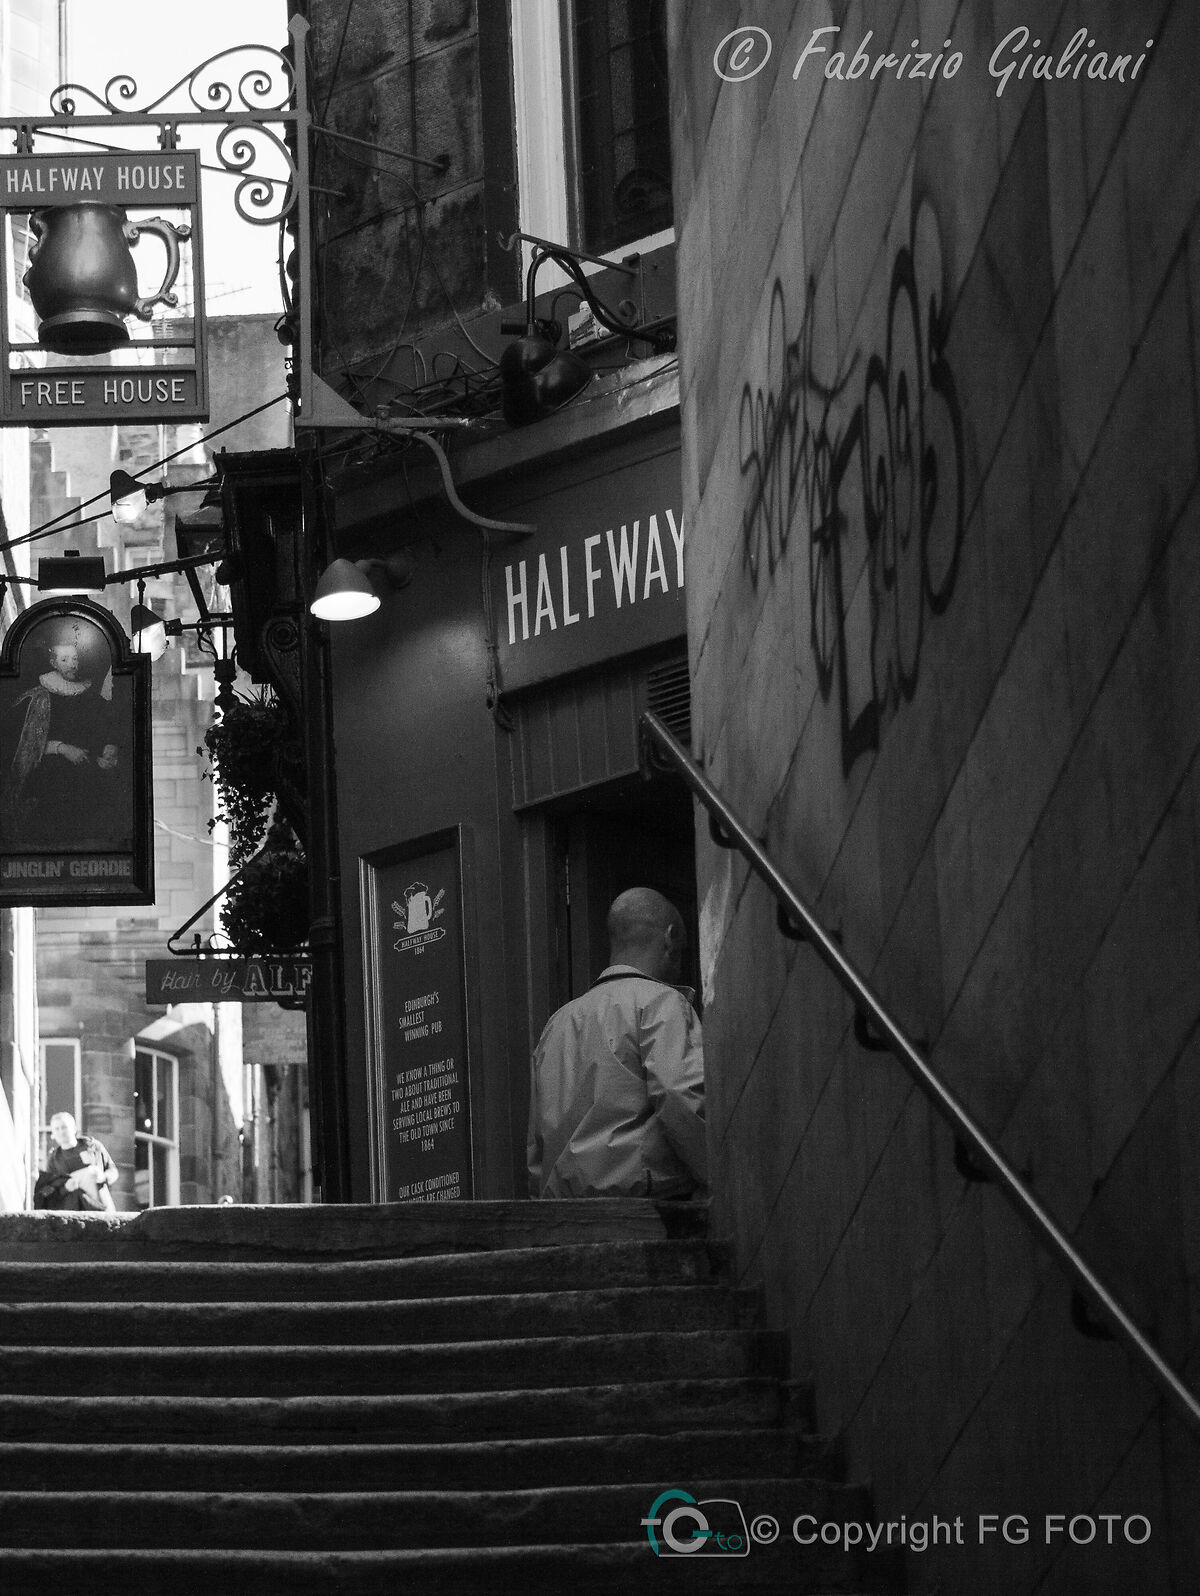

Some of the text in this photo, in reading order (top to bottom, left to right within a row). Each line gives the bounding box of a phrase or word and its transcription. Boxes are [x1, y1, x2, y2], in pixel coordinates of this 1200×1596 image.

[6, 165, 186, 193] HALFWAY HOUSE
[20, 378, 186, 406] FREE HOUSE
[504, 508, 685, 645] HALFWAY
[3, 859, 131, 878] JINGLIN' GEORDIE
[401, 930, 439, 948] HALFWAY HOUSE
[161, 969, 200, 991] Hair
[212, 967, 241, 994] by
[404, 991, 440, 1013] EDINBURGH'S
[398, 1011, 425, 1029] SMALLEST
[404, 1020, 443, 1042] WINNING PUB
[396, 1057, 455, 1085] WE KNOW A THING OR
[391, 1071, 459, 1101] TWO ABOUT TRADITIONAL
[400, 1088, 452, 1114] ALE AND HAVE BEEN
[392, 1101, 460, 1131] SERVING LOCAL BREWS TO
[399, 1117, 455, 1144] THE OLD TOWN SINCE
[421, 1137, 435, 1153] 1864
[399, 1185, 410, 1199] OUR
[410, 1181, 425, 1196] CASK
[425, 1171, 460, 1191] CONDITIONED
